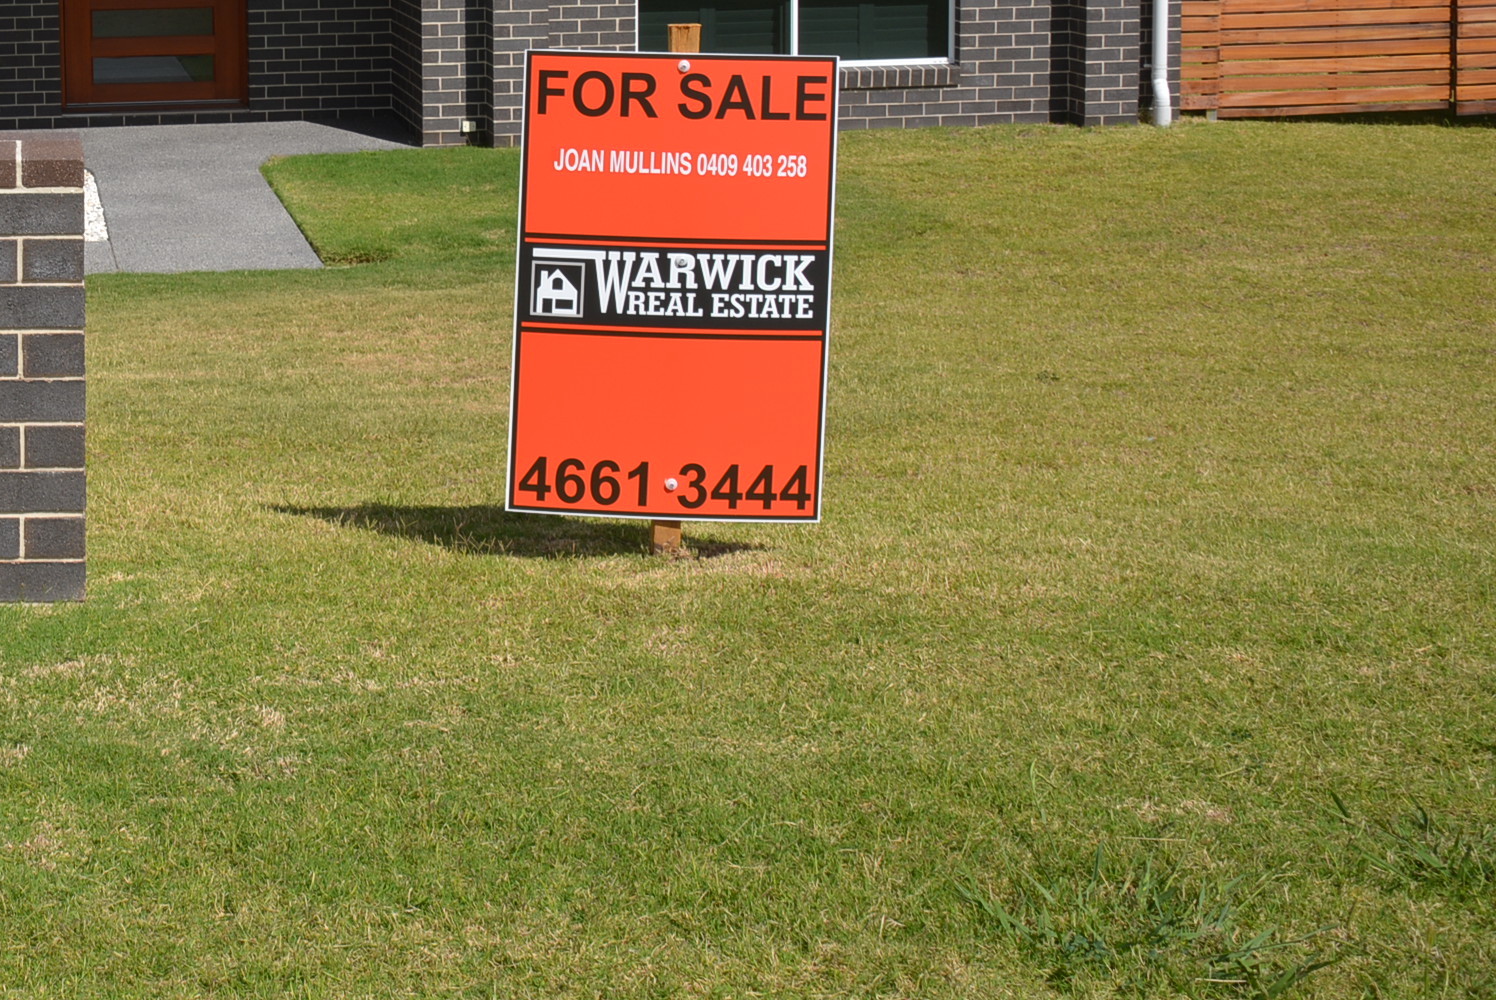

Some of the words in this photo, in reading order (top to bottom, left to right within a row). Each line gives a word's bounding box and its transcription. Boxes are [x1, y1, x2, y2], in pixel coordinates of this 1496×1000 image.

[537, 69, 658, 118] FOR
[677, 72, 828, 121] SALE
[553, 147, 605, 173] JOAN
[609, 150, 692, 176] MULLINS
[696, 153, 739, 177] 0409
[742, 154, 773, 177] 403
[776, 154, 808, 178] 258
[589, 249, 816, 314] WARWICK
[626, 291, 704, 318] REAL
[710, 293, 815, 319] ESTATE
[518, 456, 650, 507] 4661
[677, 463, 812, 510] 3444
